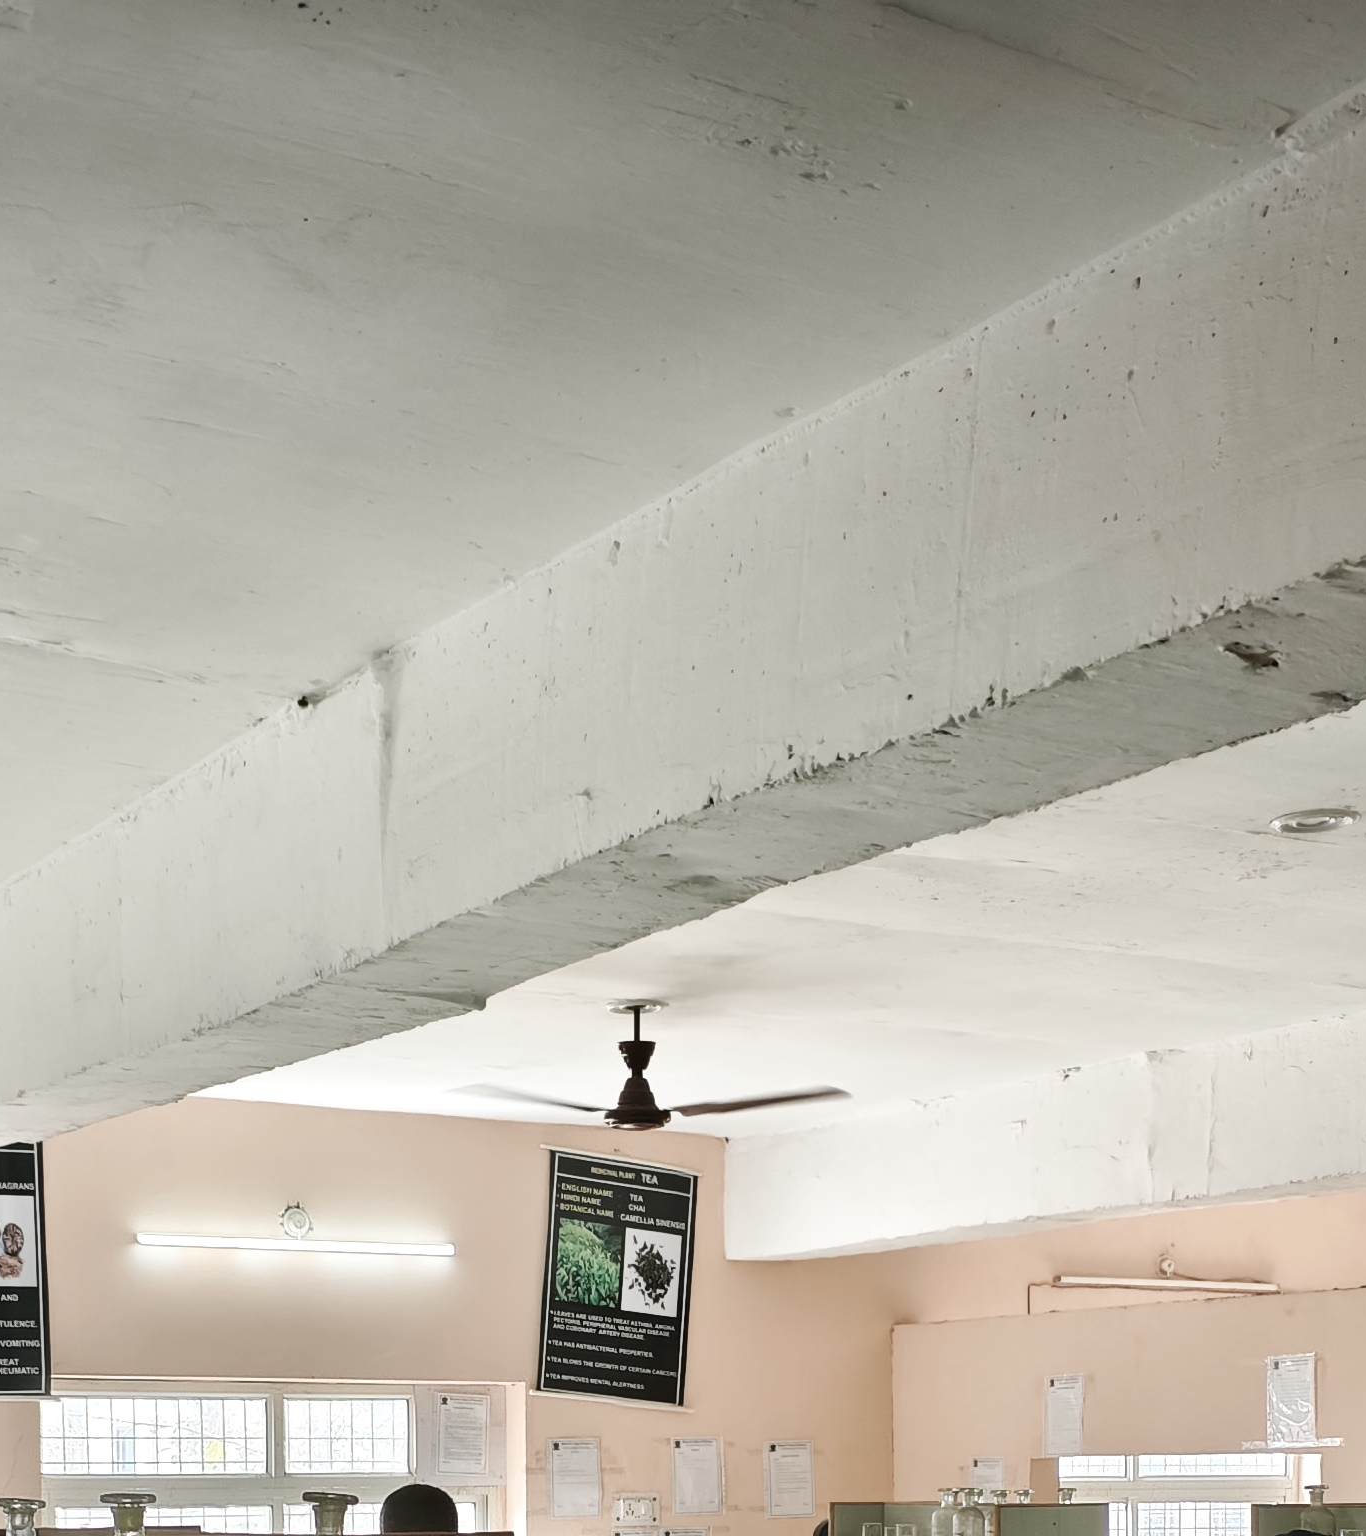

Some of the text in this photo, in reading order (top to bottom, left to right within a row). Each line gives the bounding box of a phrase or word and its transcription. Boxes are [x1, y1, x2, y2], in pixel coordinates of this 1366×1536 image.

[641, 1173, 658, 1185] TEA
[593, 1188, 613, 1198] NAME
[629, 1194, 643, 1202] TEA
[582, 1196, 645, 1212] NAME CHAI
